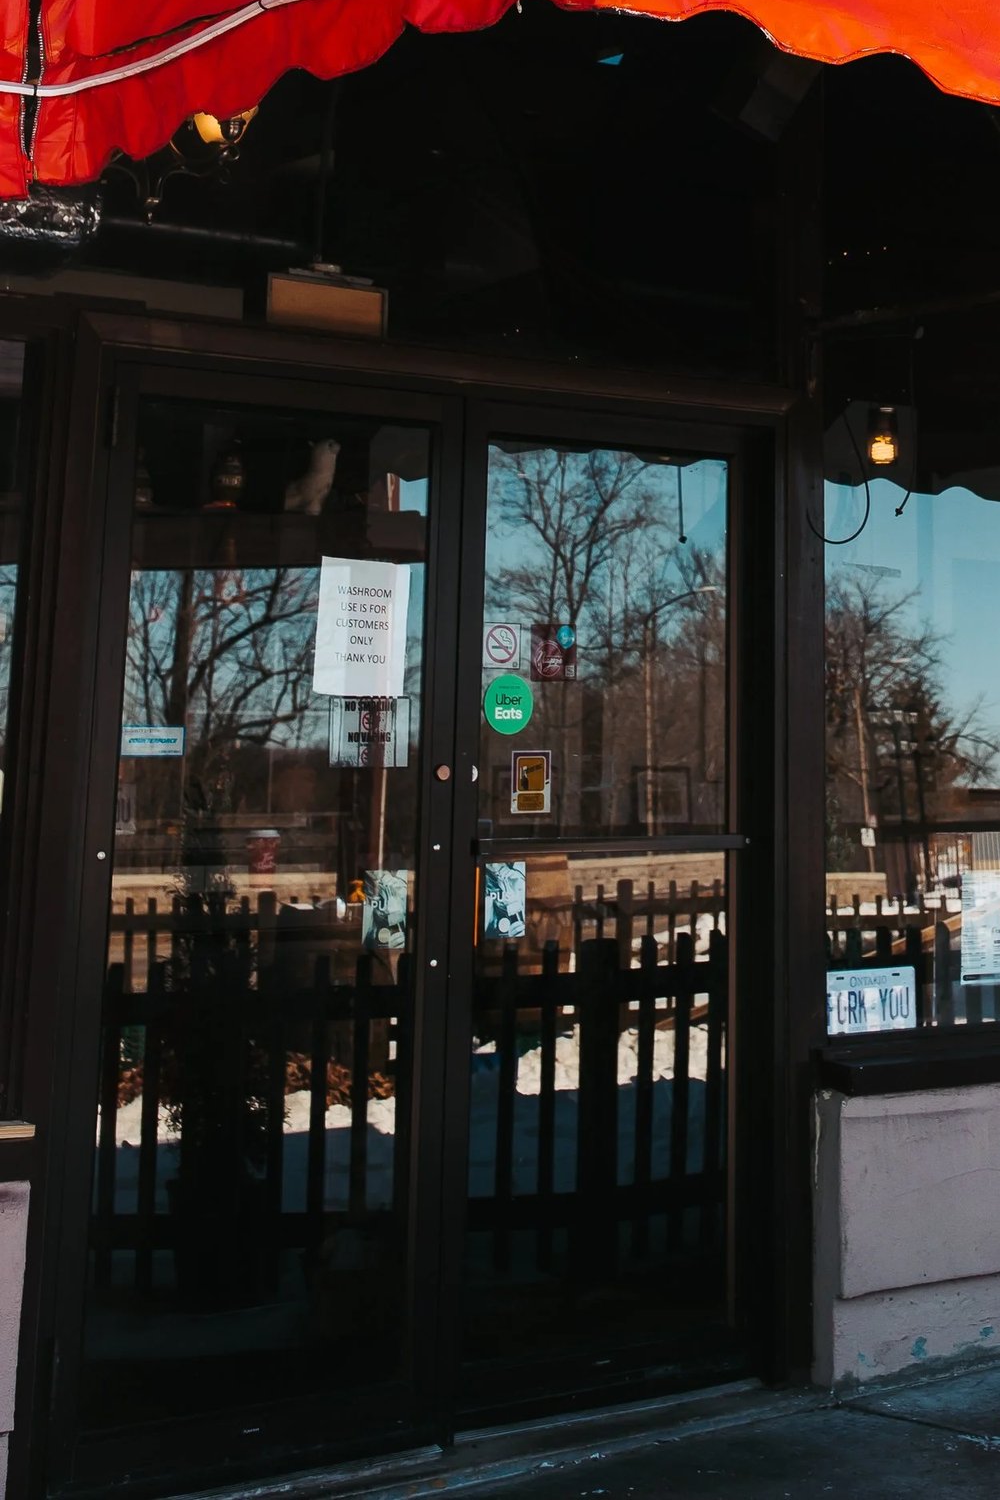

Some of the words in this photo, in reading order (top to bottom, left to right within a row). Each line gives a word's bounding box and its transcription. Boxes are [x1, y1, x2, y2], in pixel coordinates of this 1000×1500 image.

[337, 585, 392, 598] WASHROOM
[341, 602, 358, 612] USE
[359, 603, 367, 613] IS
[369, 604, 387, 614] FOR
[336, 618, 389, 630] CUSTOMERS
[350, 635, 373, 645] ONLY
[335, 652, 365, 663] THANK
[367, 654, 386, 664] YOU
[344, 700, 356, 712] NO
[495, 694, 523, 706] Uber
[494, 707, 523, 720] Eats
[347, 732, 360, 743] NO
[879, 986, 910, 1022] YOU
